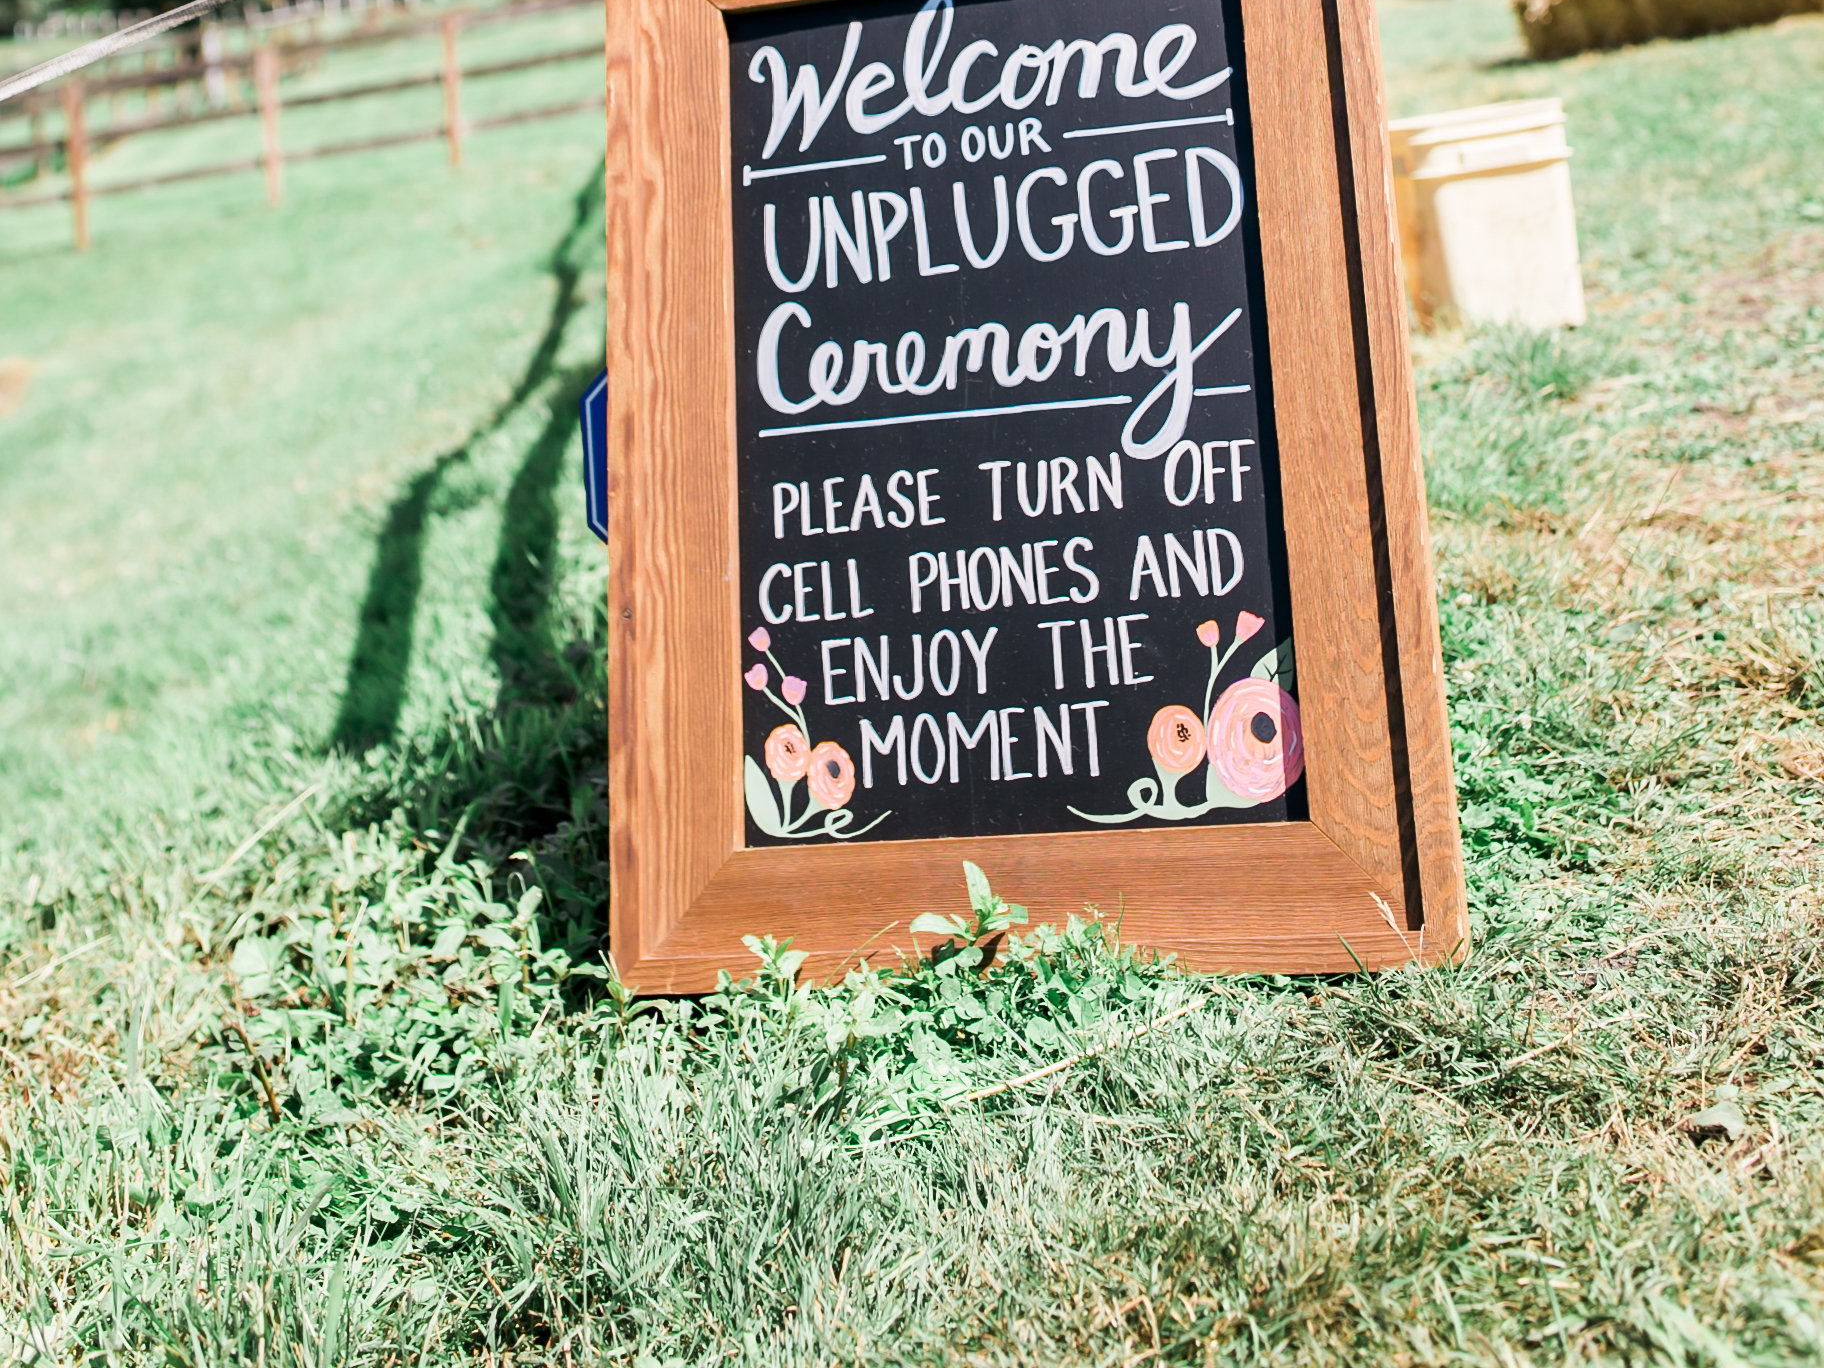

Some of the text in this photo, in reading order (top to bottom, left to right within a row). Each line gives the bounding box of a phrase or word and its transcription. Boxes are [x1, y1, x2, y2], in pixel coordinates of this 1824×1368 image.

[893, 117, 1053, 171] TO OUR
[763, 146, 1245, 293] UNPLUGGED
[756, 301, 1243, 460] Ceremony
[772, 438, 1256, 540] PLEASE TURN OFF
[758, 527, 1245, 625] CELL PHONES AND
[820, 613, 1155, 706] ENJOY THE
[858, 700, 1110, 789] MOMENT
